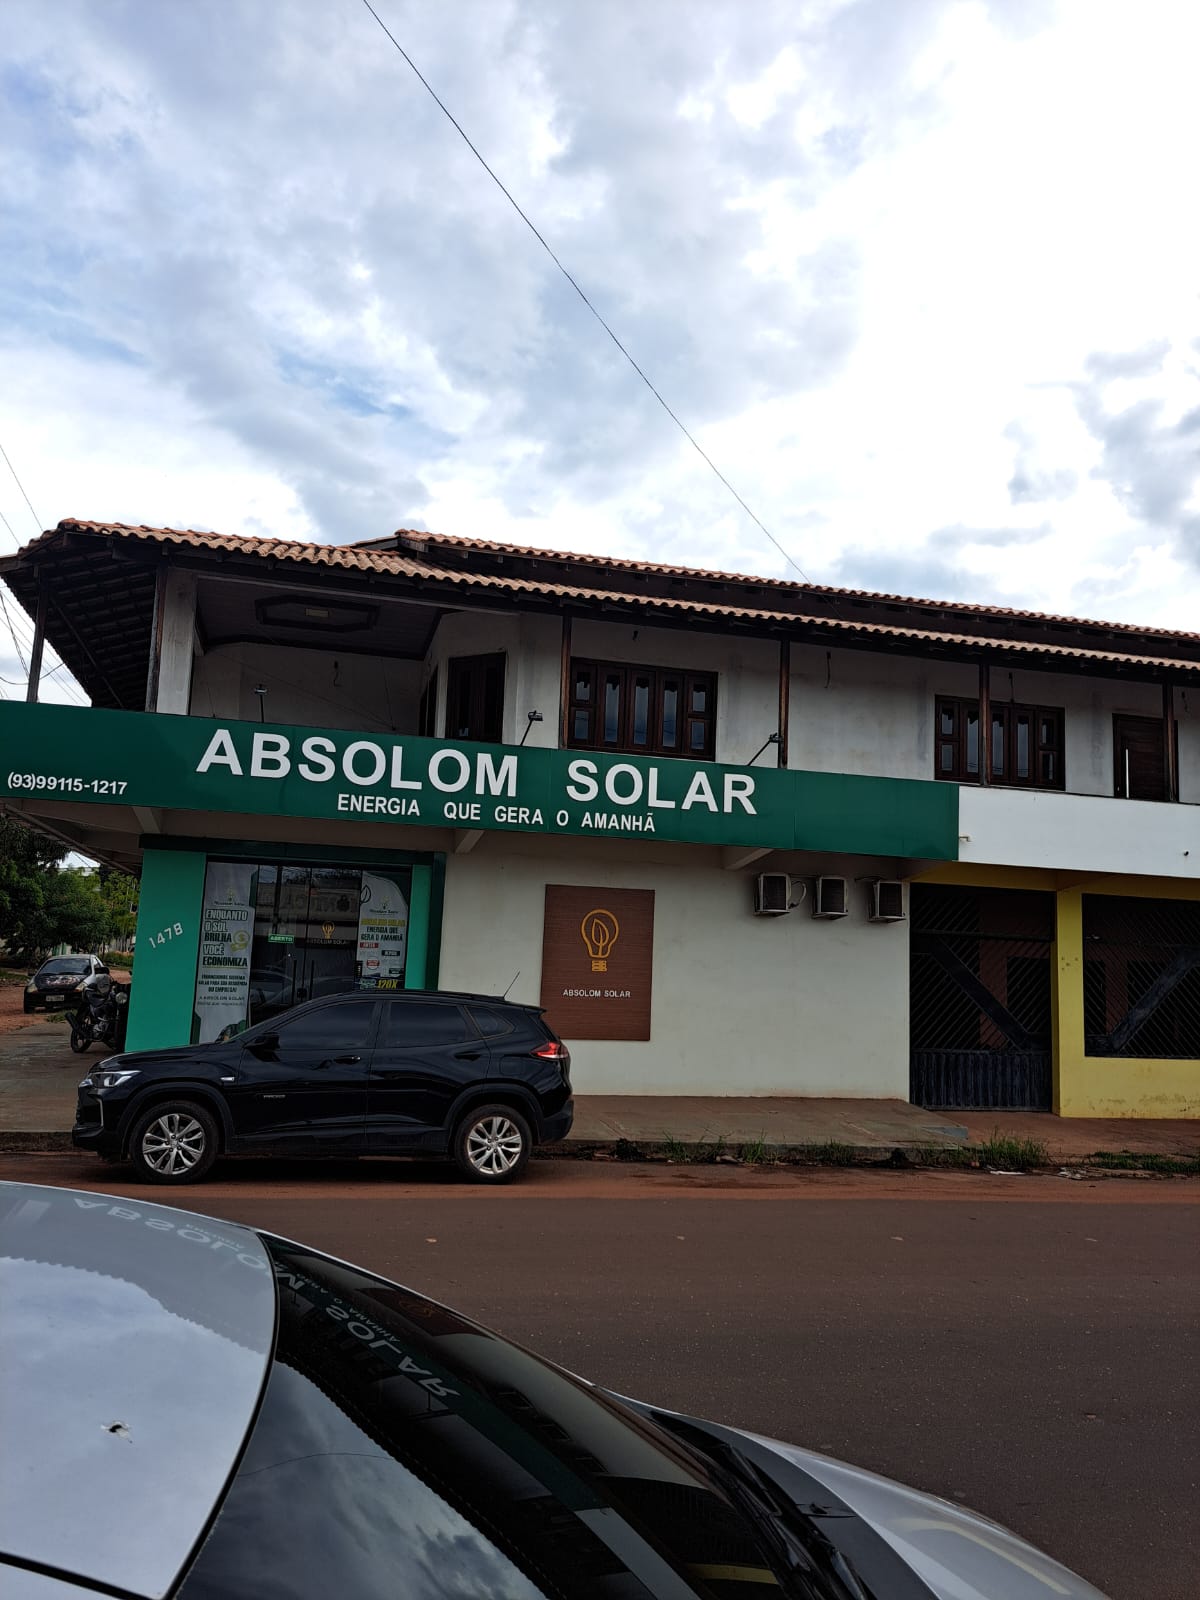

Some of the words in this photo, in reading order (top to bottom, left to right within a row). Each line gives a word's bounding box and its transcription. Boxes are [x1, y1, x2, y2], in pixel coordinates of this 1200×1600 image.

[195, 728, 519, 798] ABSOLOM
[566, 759, 758, 816] SOLAR
[7, 771, 128, 796] (93)99115-1217
[337, 794, 421, 816] ENERGIA
[443, 801, 481, 821] QUE
[494, 805, 544, 826] GERA
[556, 809, 570, 827] O
[581, 811, 656, 832] AMANHÃ
[205, 908, 248, 921] ENQUANTO
[204, 920, 211, 932] O
[212, 921, 228, 932] SOL
[204, 932, 232, 942] BRILHA
[202, 956, 248, 967] ECONOMIZA
[562, 988, 601, 998] ABSOLOM
[604, 990, 631, 998] SOLAR
